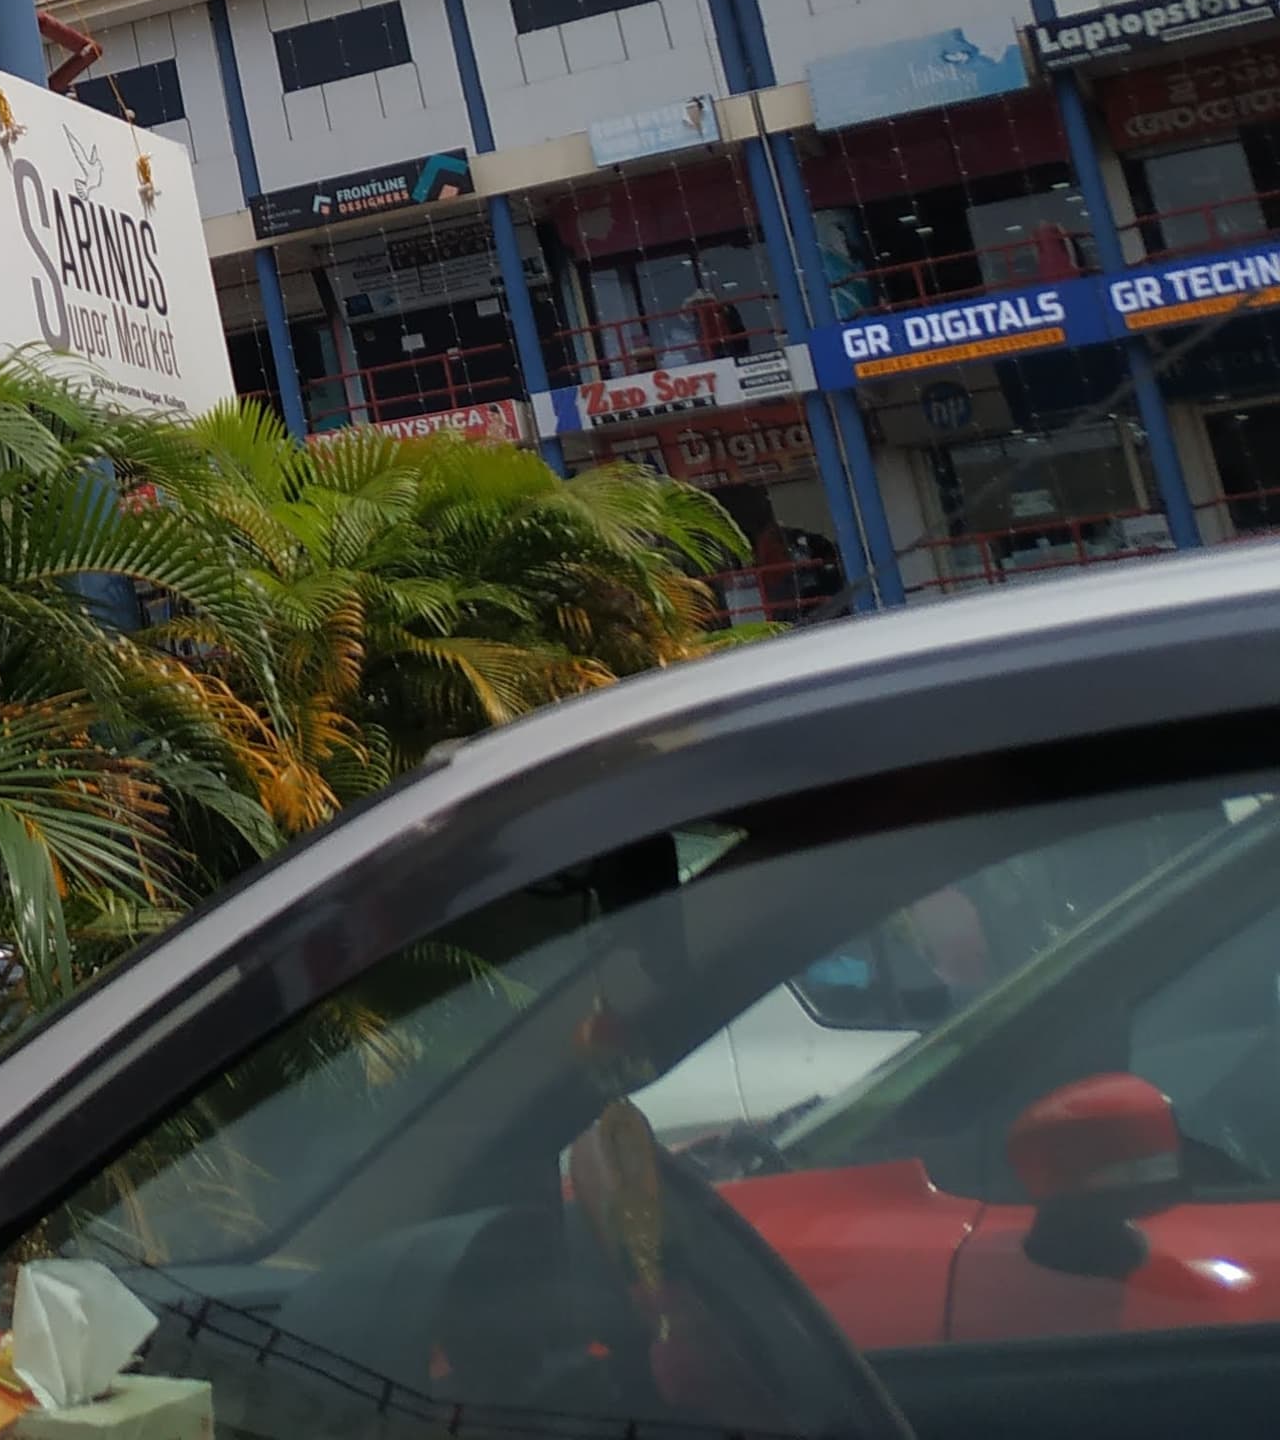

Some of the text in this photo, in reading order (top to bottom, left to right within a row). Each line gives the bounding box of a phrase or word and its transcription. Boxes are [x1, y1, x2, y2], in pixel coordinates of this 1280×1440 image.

[336, 176, 407, 203] FRONTLINE
[338, 191, 410, 215] DESIGNERS
[1111, 276, 1165, 312] GR
[112, 302, 182, 379] Market
[843, 324, 892, 359] GR
[904, 291, 1065, 347] DIGITALS
